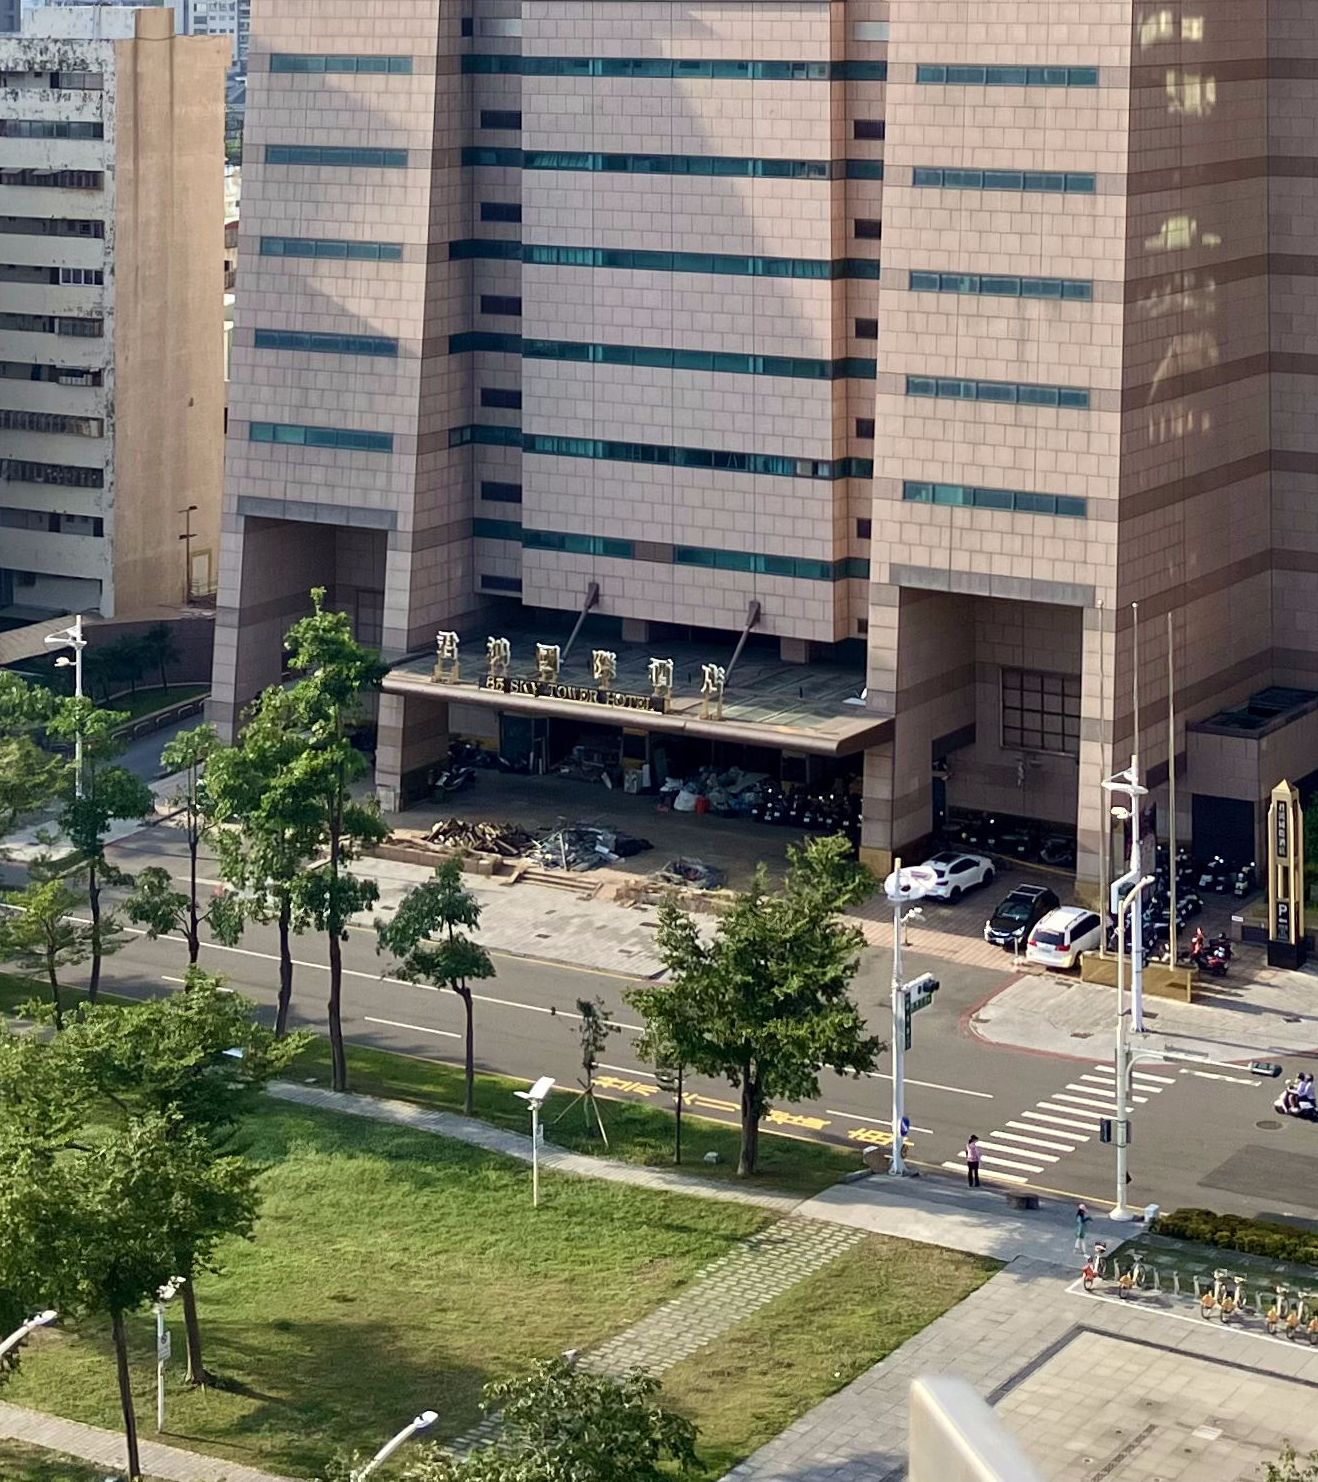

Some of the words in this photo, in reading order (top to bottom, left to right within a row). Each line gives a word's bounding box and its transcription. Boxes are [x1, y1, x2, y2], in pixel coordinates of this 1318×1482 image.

[436, 630, 726, 693] 君鴻國際酒店
[486, 676, 505, 690] 85
[510, 680, 540, 696] SKY
[548, 684, 598, 703] TOWER
[605, 692, 655, 712] HOTEL
[1278, 904, 1288, 916] P
